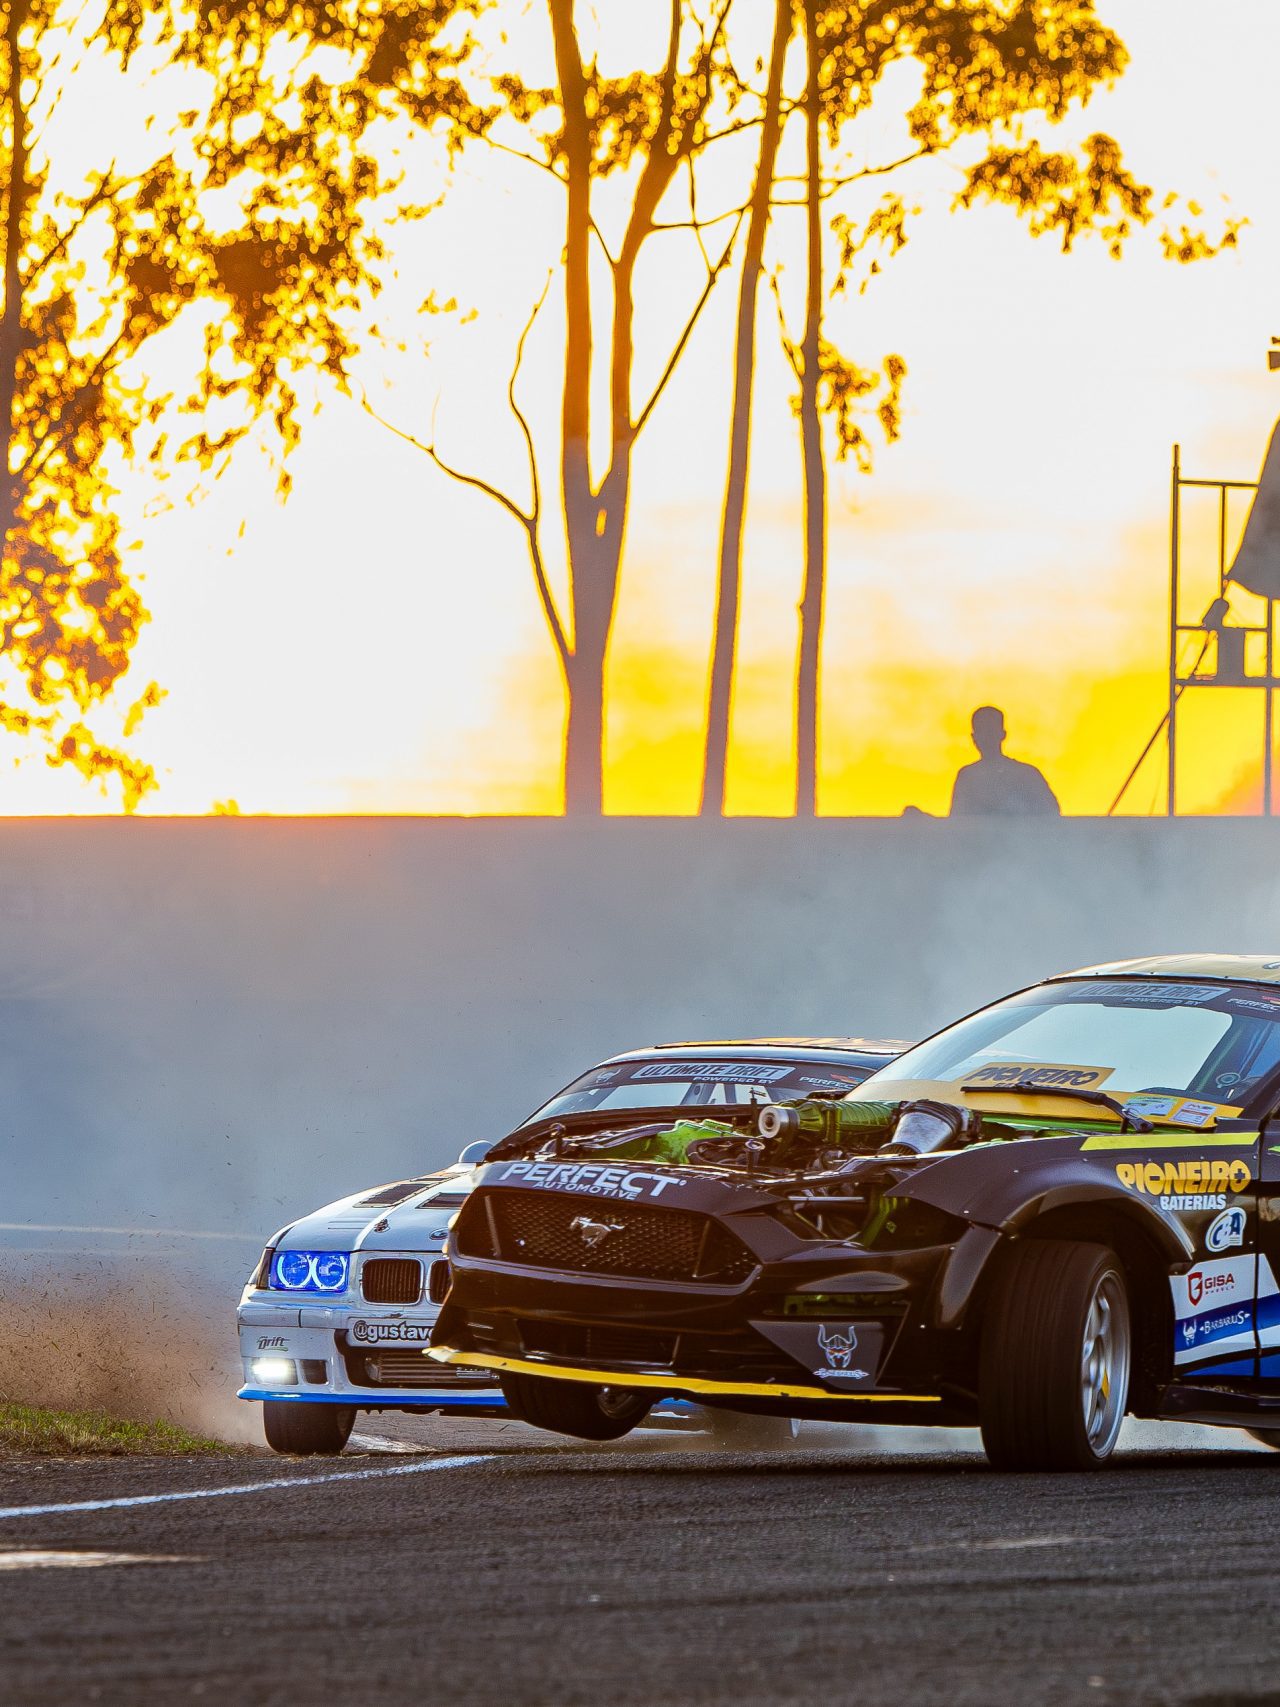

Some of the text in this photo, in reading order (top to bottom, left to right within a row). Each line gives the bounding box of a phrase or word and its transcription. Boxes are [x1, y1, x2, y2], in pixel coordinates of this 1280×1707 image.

[1080, 984, 1214, 1002] ULTIMATE DRIFT
[1124, 997, 1183, 1005] POWERED
[640, 1064, 785, 1079] ULTIMATE DRIFT
[692, 1076, 755, 1084] POWERED
[974, 1067, 1100, 1086] PIONEIRO
[800, 1076, 860, 1088] PERFEC
[499, 1163, 681, 1198] PERFECT
[1116, 1160, 1251, 1195] PIONEIRO
[534, 1180, 639, 1200] AUTOMOTIVE
[1160, 1194, 1226, 1211] BATERIAS
[1204, 1273, 1235, 1290] GISA
